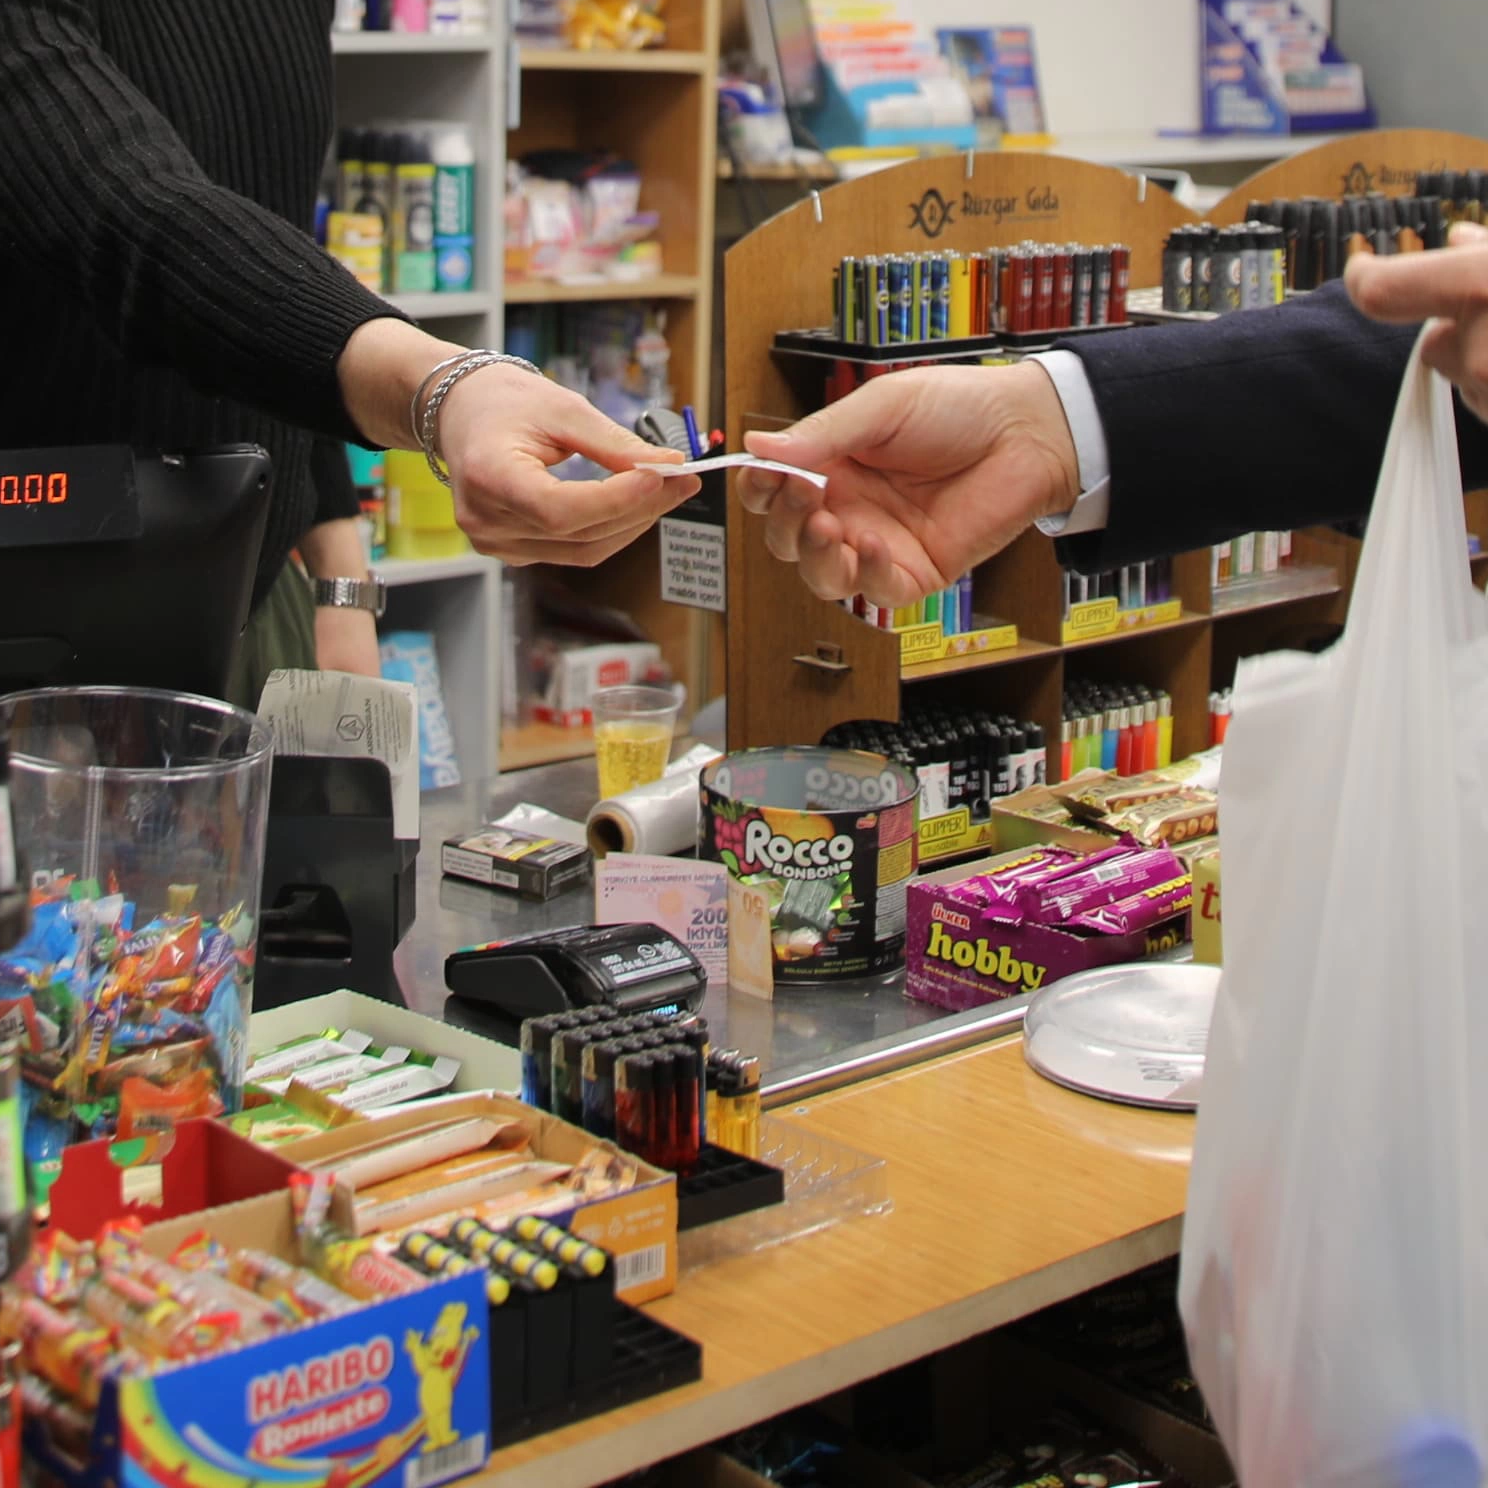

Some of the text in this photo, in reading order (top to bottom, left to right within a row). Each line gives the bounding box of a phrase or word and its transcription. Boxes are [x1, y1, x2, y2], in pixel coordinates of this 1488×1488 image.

[1075, 605, 1112, 626] CLIPPER
[903, 629, 938, 650] LIPPER
[920, 816, 963, 840] CLIPPER
[773, 862, 840, 881] BONBON
[691, 909, 728, 925] 200
[932, 903, 970, 930] ÜLKER
[927, 922, 1047, 994] hobby
[250, 1337, 393, 1422] HARIBO
